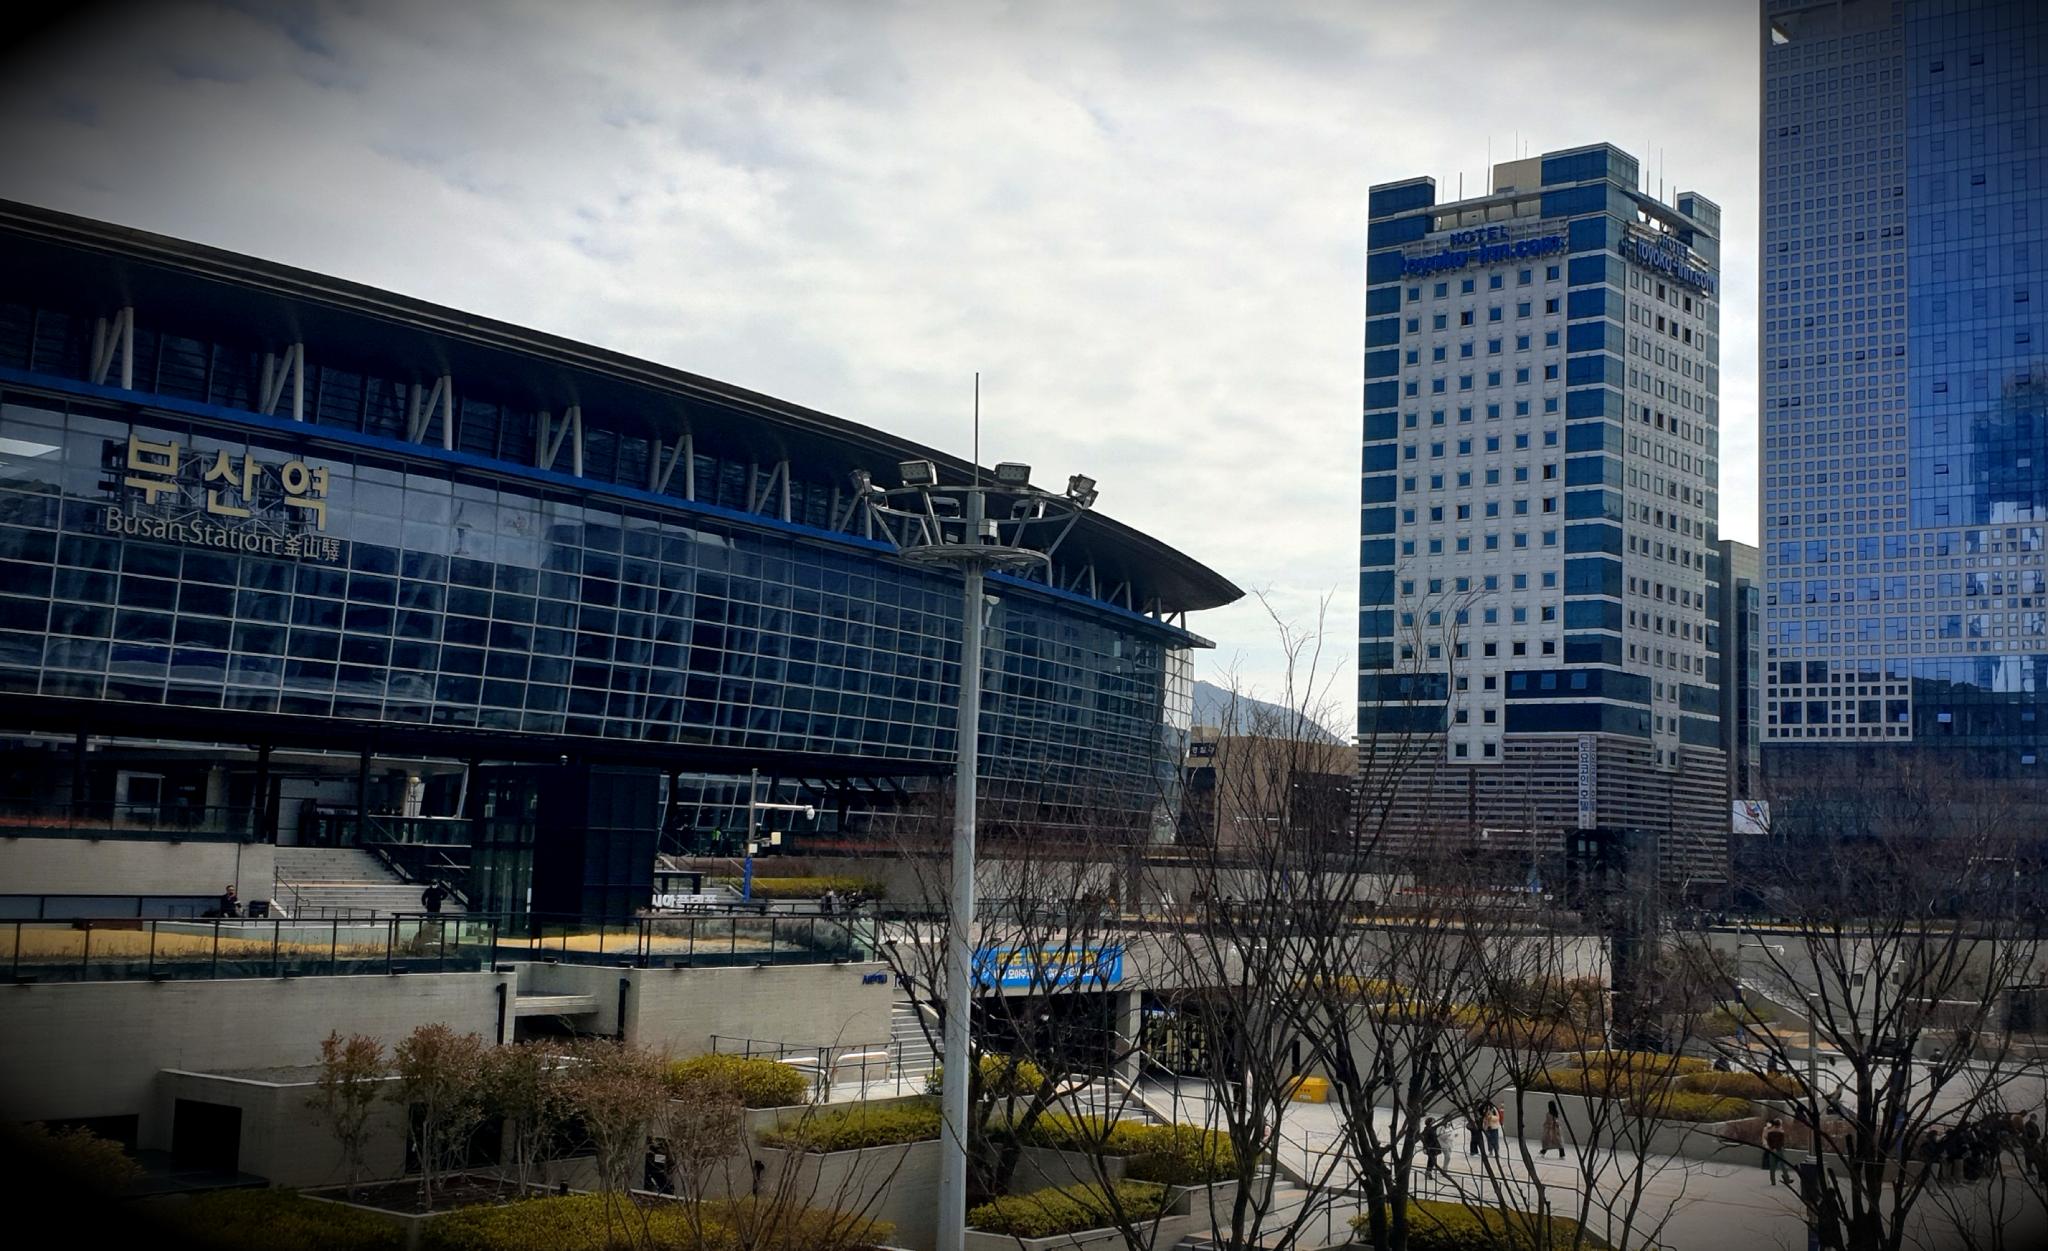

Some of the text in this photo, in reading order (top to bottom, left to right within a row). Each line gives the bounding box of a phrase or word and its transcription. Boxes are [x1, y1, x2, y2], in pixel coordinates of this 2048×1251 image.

[1450, 226, 1509, 245] HOTEL
[124, 433, 328, 531] 부산역
[105, 506, 341, 562] Busan Station 釜山驛
